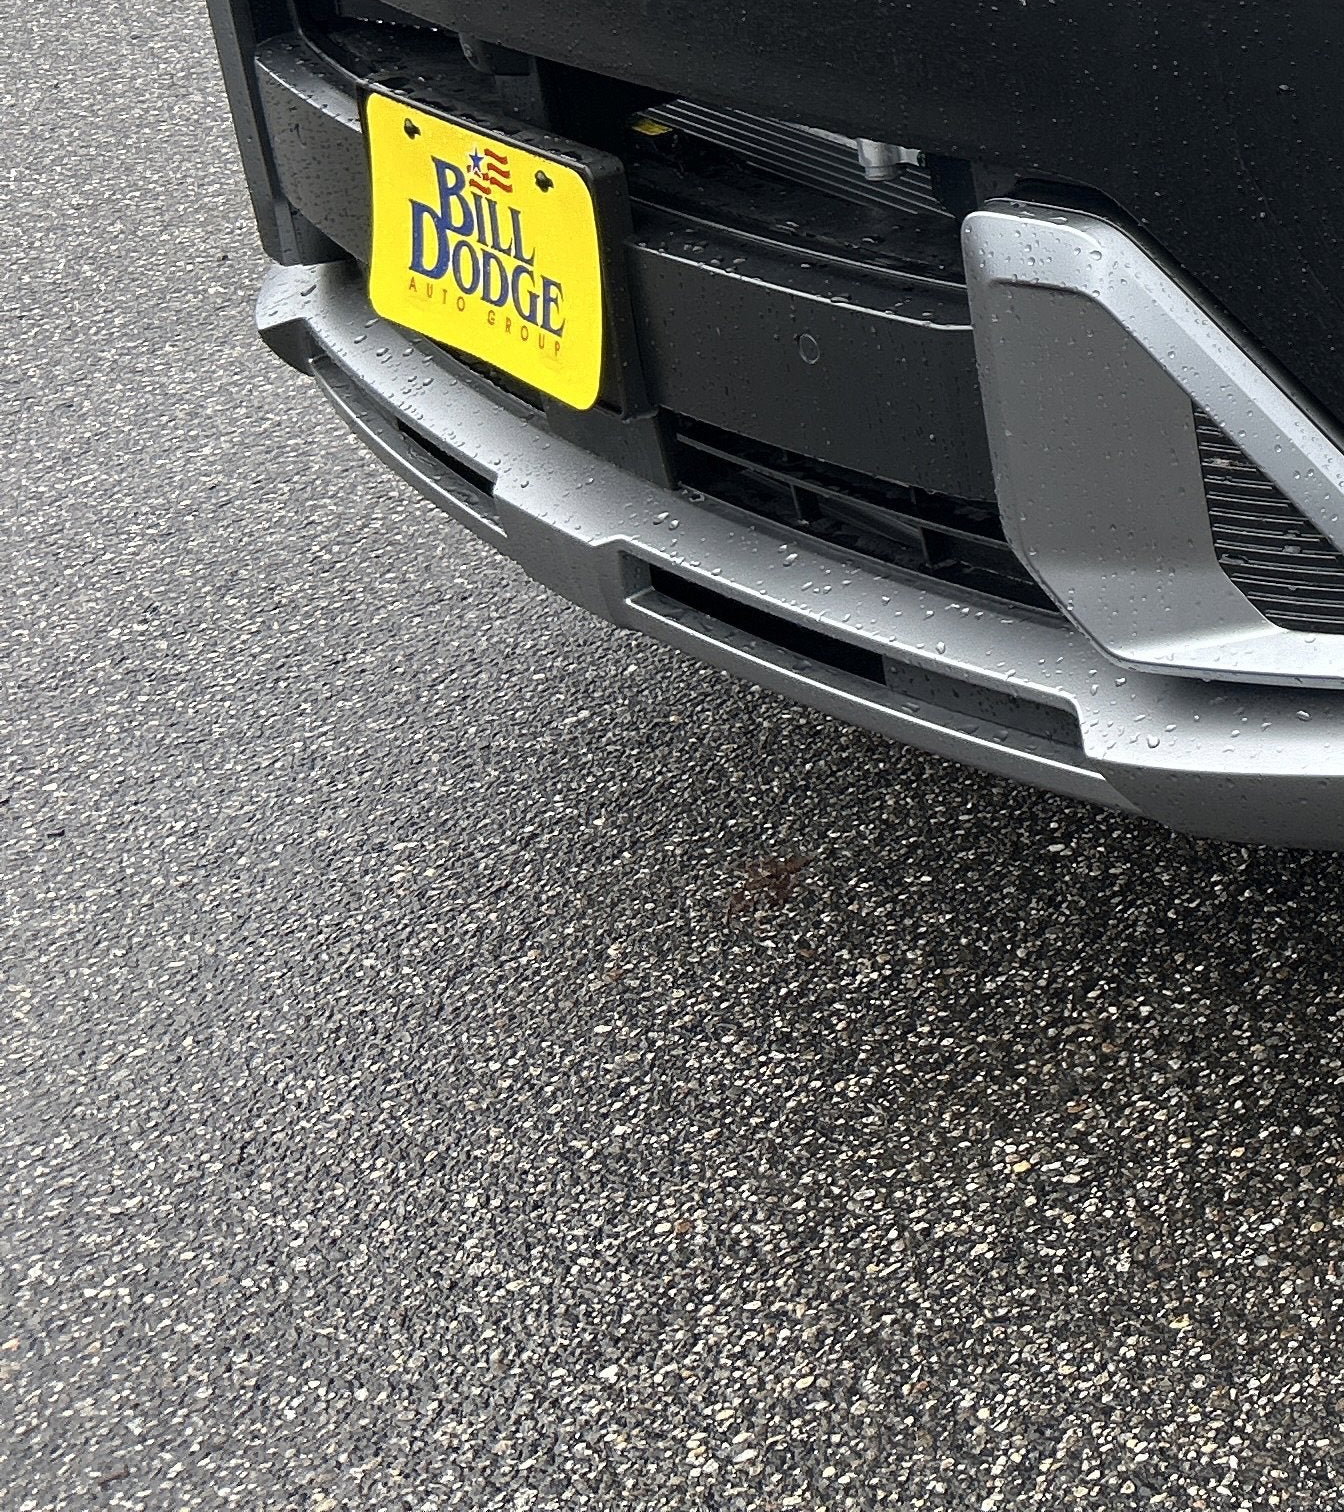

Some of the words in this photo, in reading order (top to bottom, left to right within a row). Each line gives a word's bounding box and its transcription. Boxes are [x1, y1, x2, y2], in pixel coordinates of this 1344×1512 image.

[432, 155, 536, 267] BILL
[408, 198, 567, 338] DODGE
[408, 276, 466, 313] AUTO
[487, 309, 562, 359] GROUP
